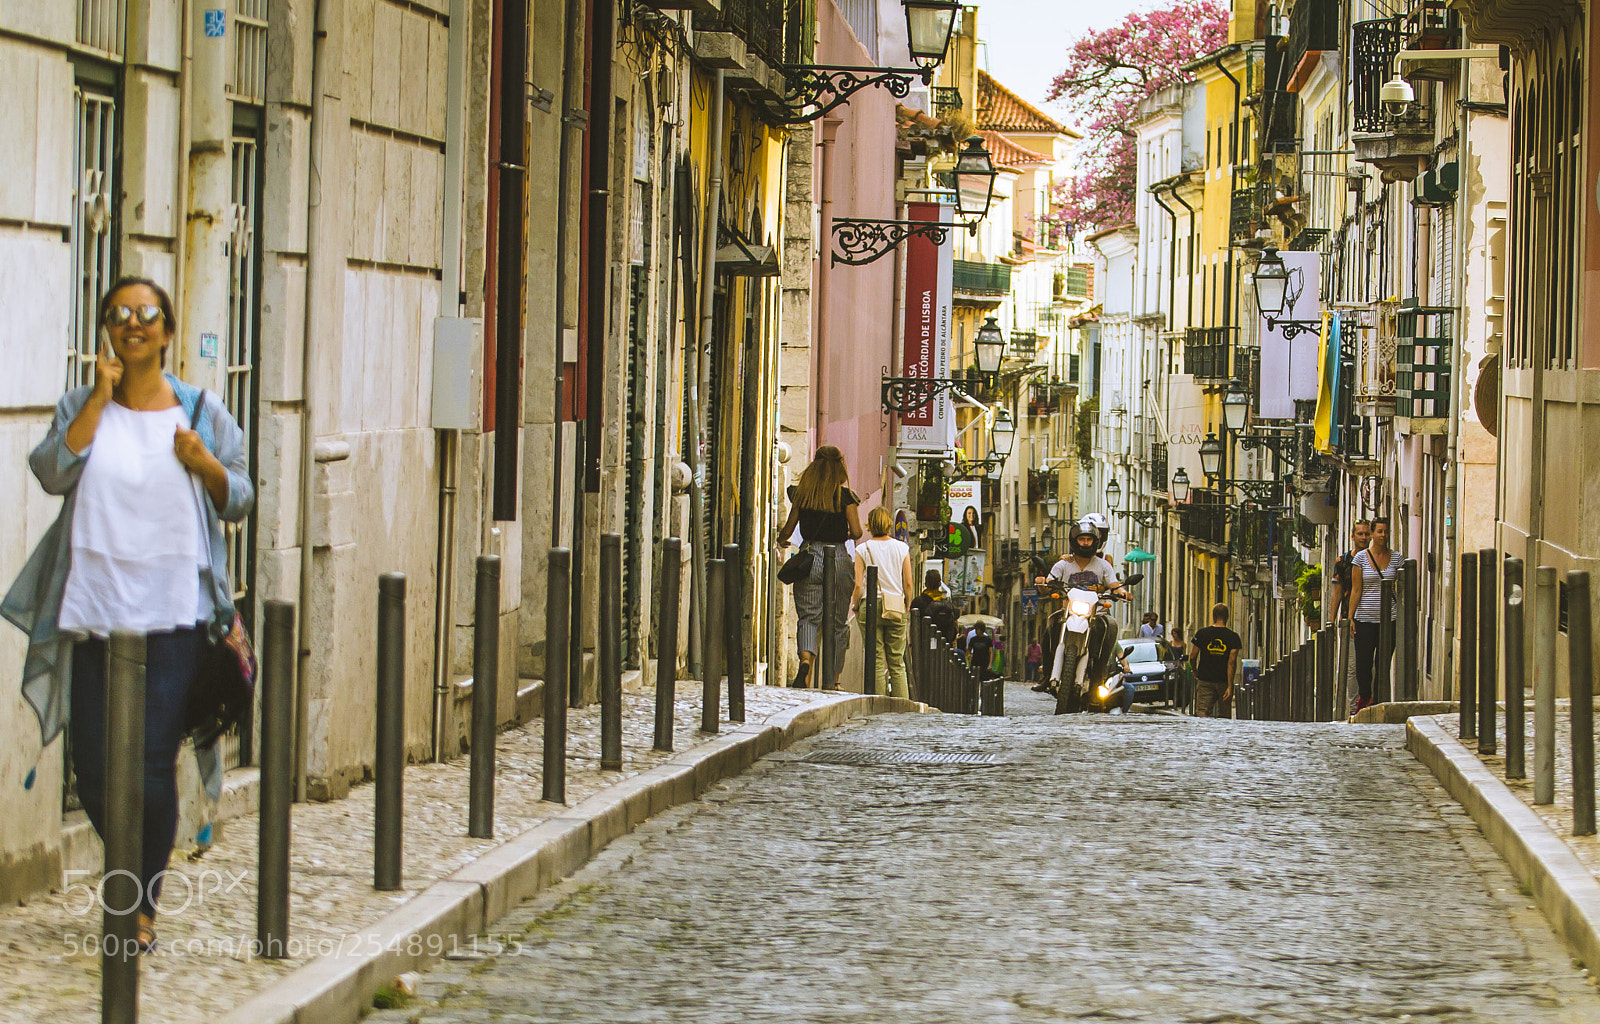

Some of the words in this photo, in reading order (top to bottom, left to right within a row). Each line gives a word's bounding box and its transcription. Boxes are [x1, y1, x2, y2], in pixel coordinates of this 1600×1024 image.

[921, 290, 931, 323] LISBOA
[939, 305, 947, 338] ALCÂNTARA
[921, 325, 930, 337] DE
[940, 339, 946, 347] DE
[919, 406, 928, 419] DA
[1170, 433, 1202, 445] CASA
